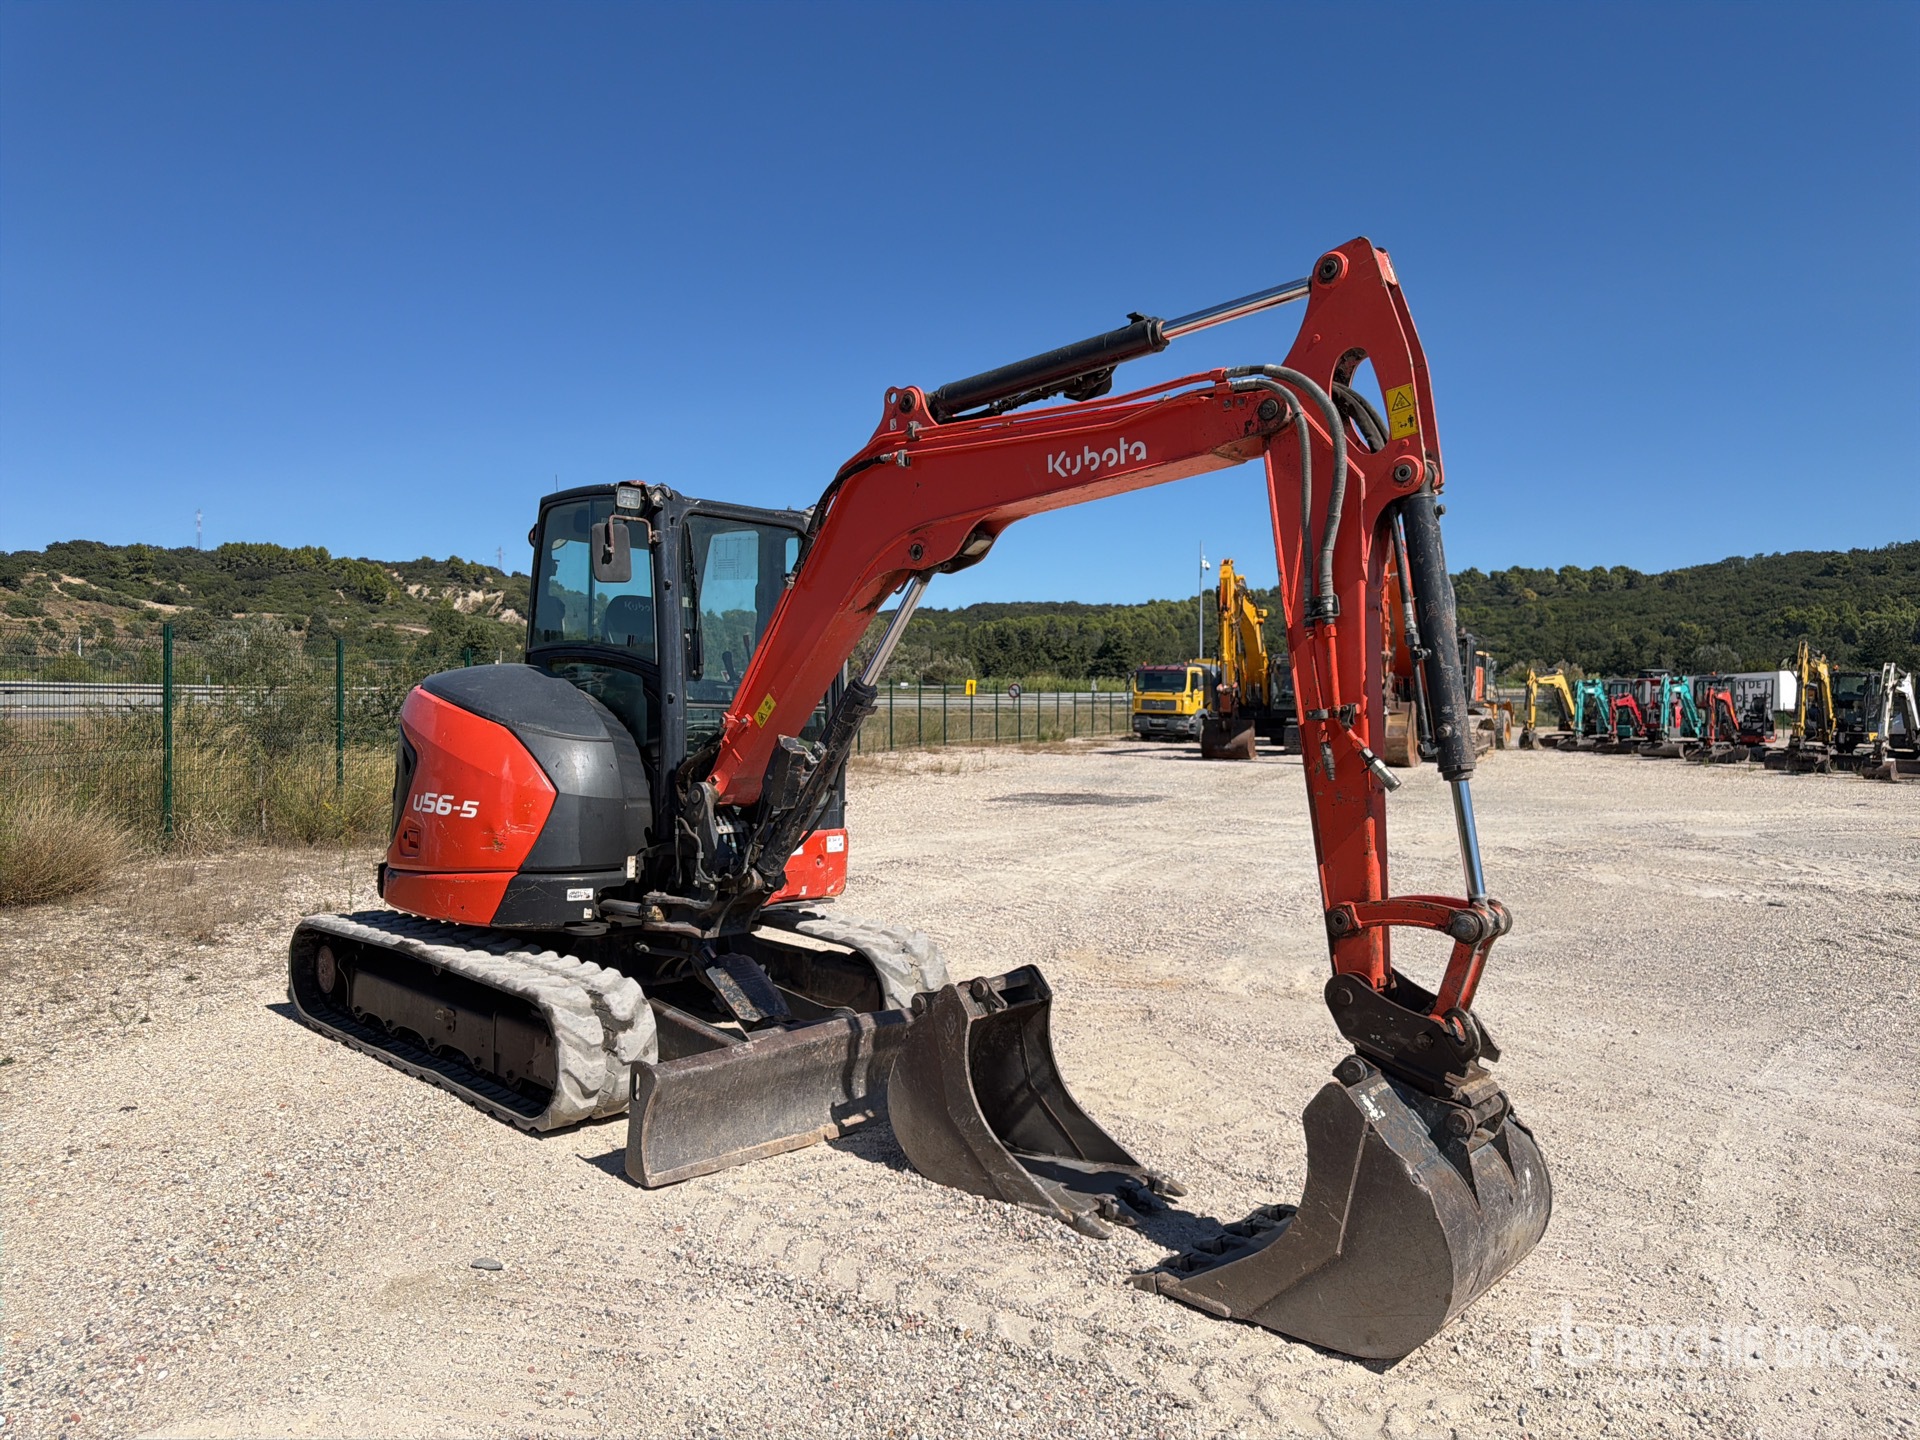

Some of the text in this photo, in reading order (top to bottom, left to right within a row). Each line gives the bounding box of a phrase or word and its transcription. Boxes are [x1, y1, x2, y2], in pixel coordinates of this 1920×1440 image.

[1047, 437, 1147, 477] Kubota
[624, 600, 652, 612] Kubo
[412, 792, 480, 818] U56-5
